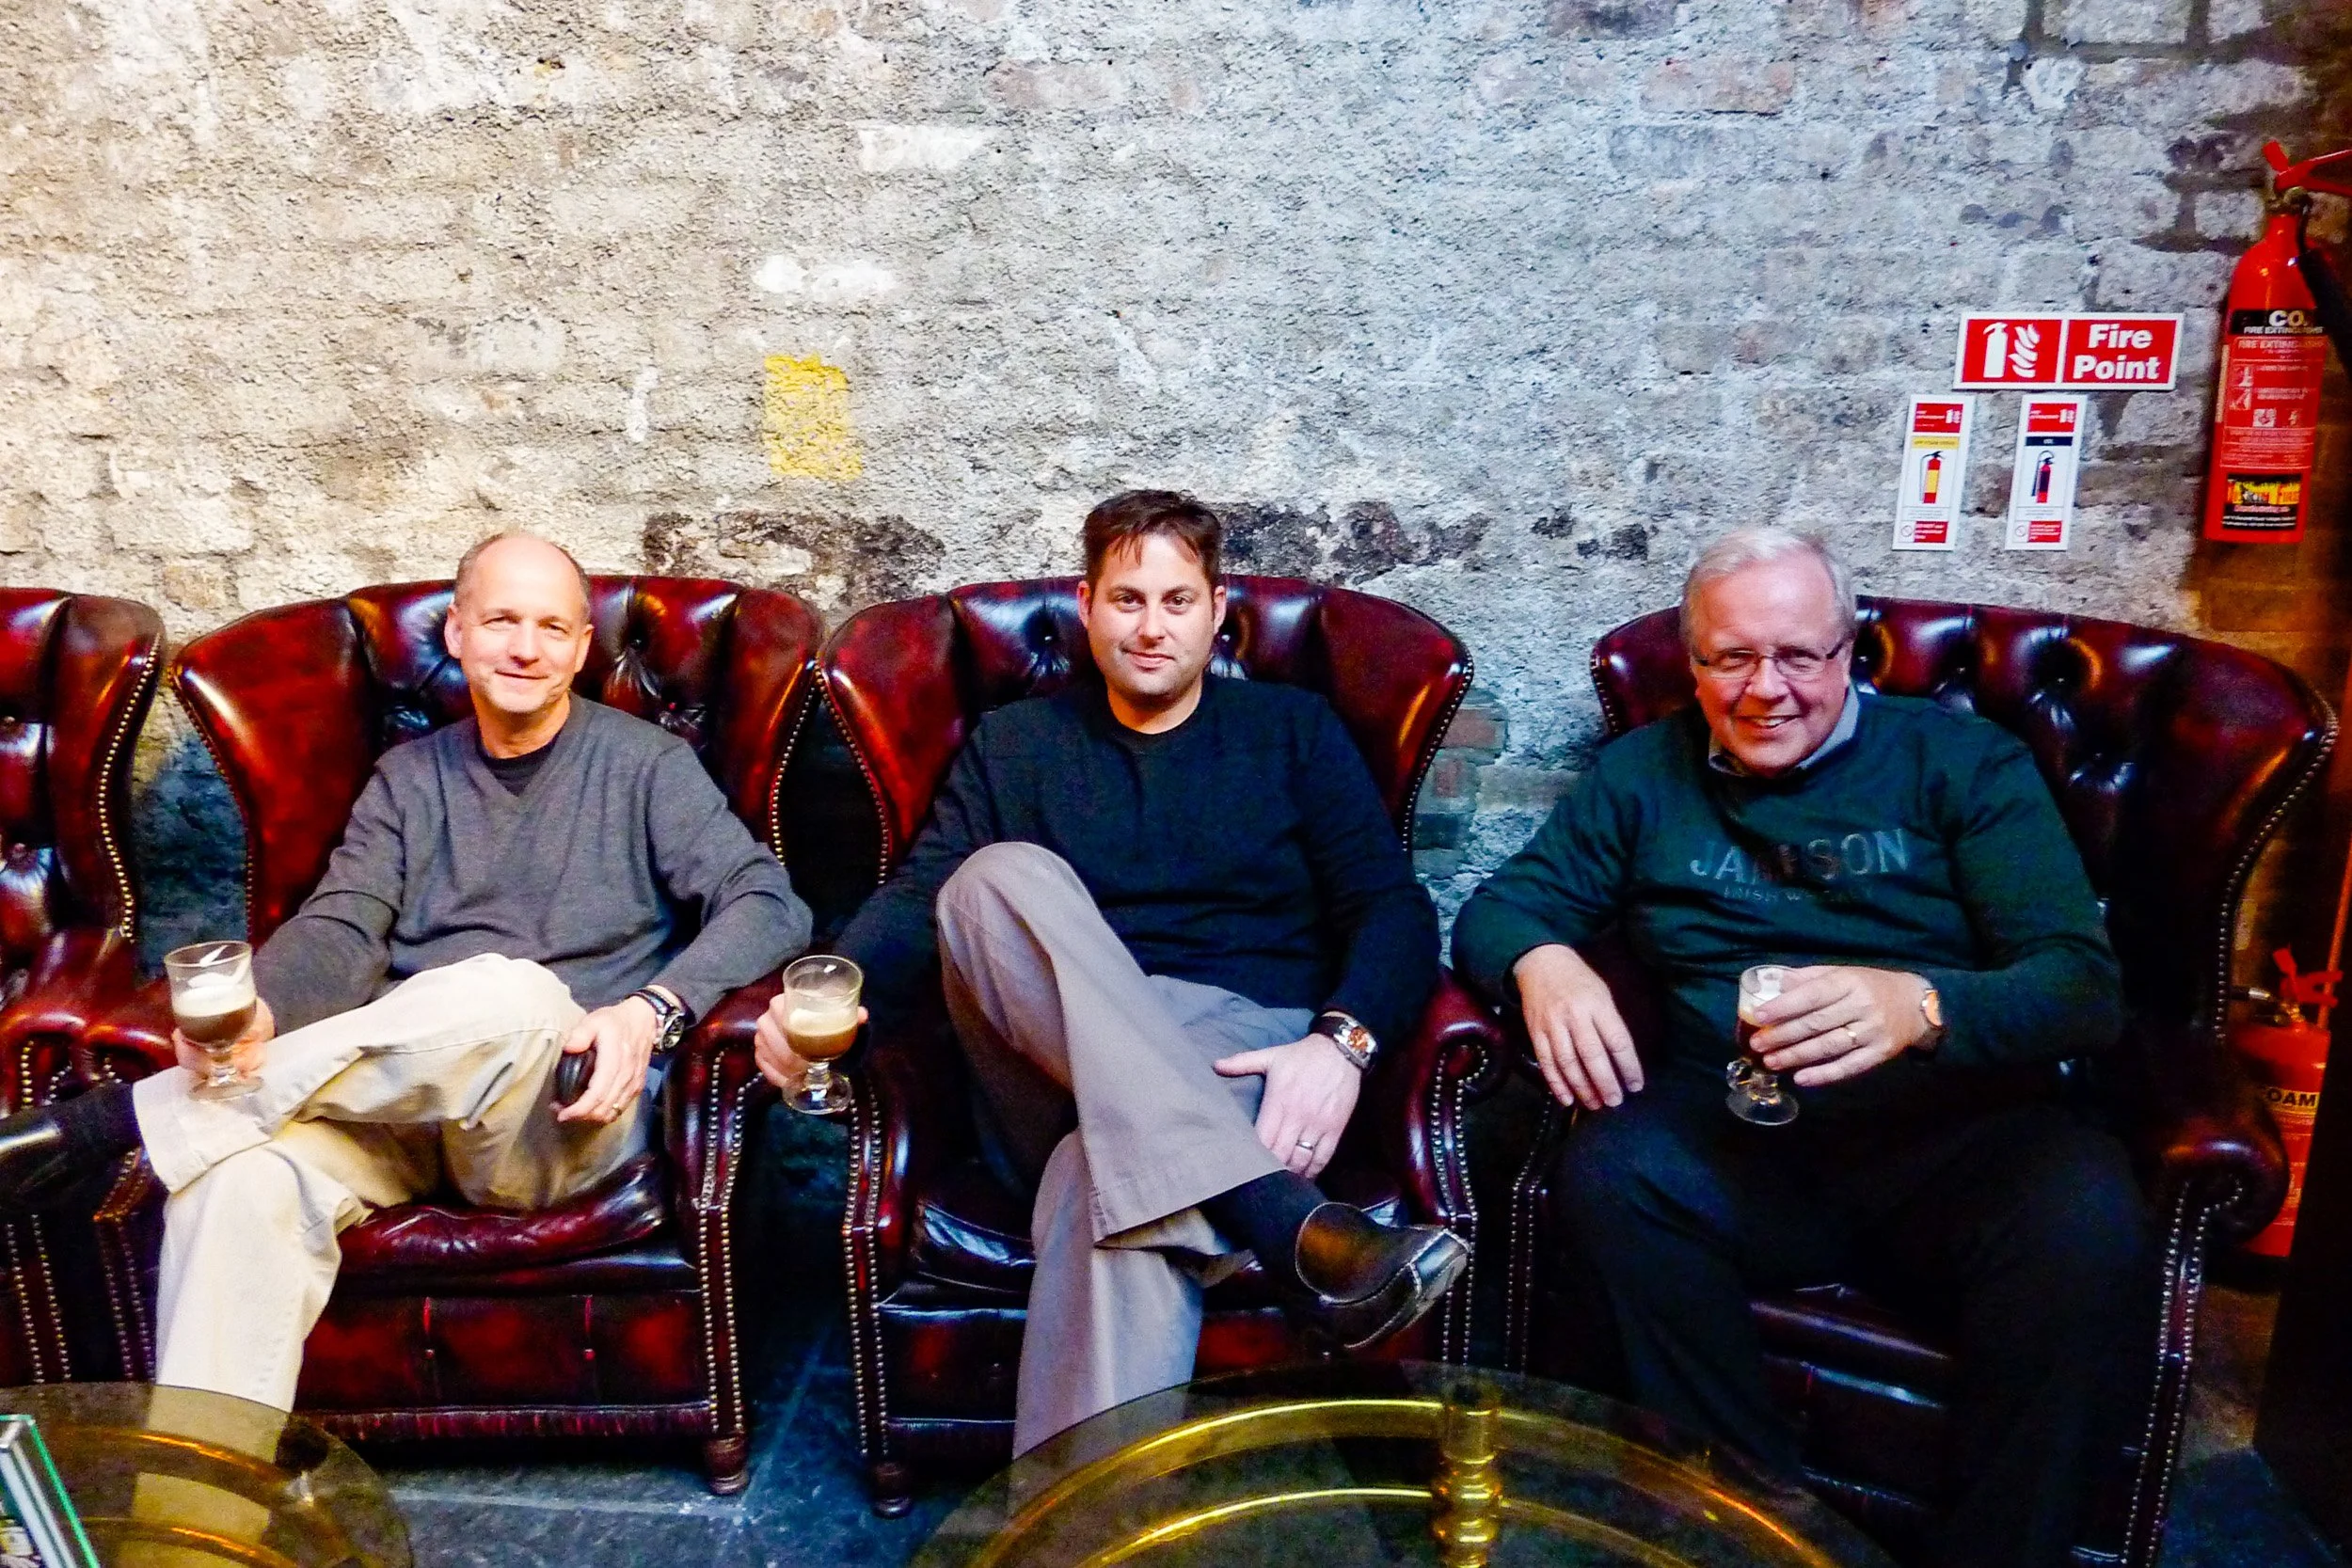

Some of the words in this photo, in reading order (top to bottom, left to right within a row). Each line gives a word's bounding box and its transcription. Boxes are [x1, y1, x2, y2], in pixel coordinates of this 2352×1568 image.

[2089, 324, 2153, 349] Fire
[2073, 355, 2161, 379] Point
[2267, 1088, 2316, 1107] OAM
